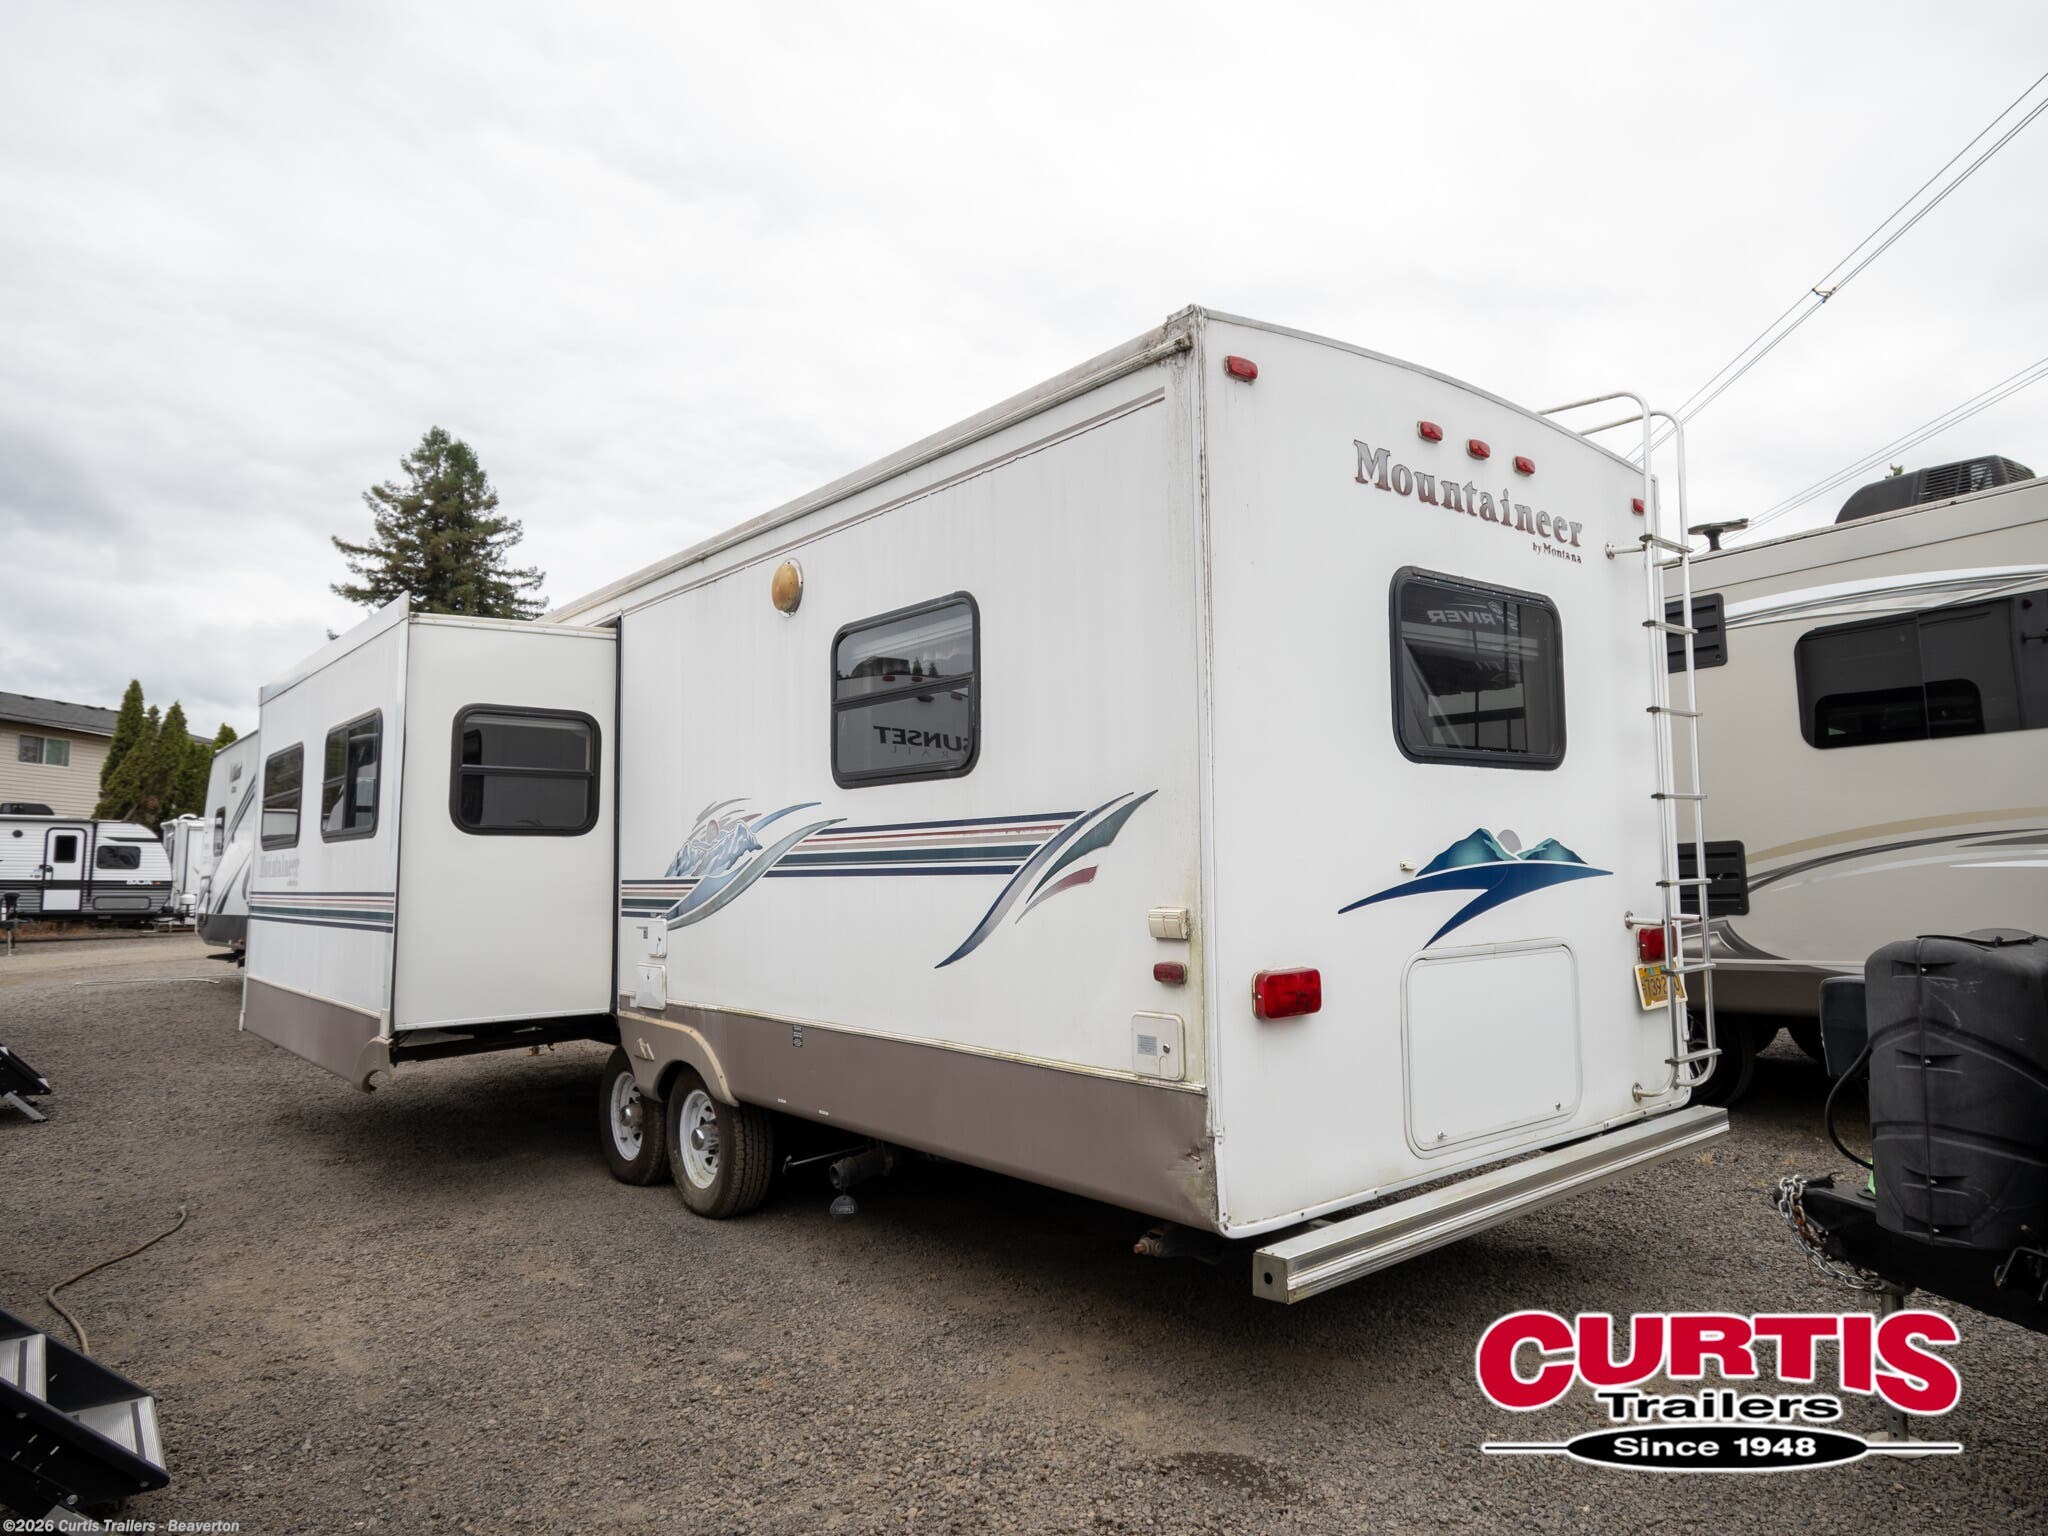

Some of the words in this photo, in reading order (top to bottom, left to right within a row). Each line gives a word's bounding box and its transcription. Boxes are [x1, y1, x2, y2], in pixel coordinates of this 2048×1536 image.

[1354, 439, 1583, 547] Mountaineer
[1532, 542, 1542, 556] by
[1543, 542, 1582, 564] Montana
